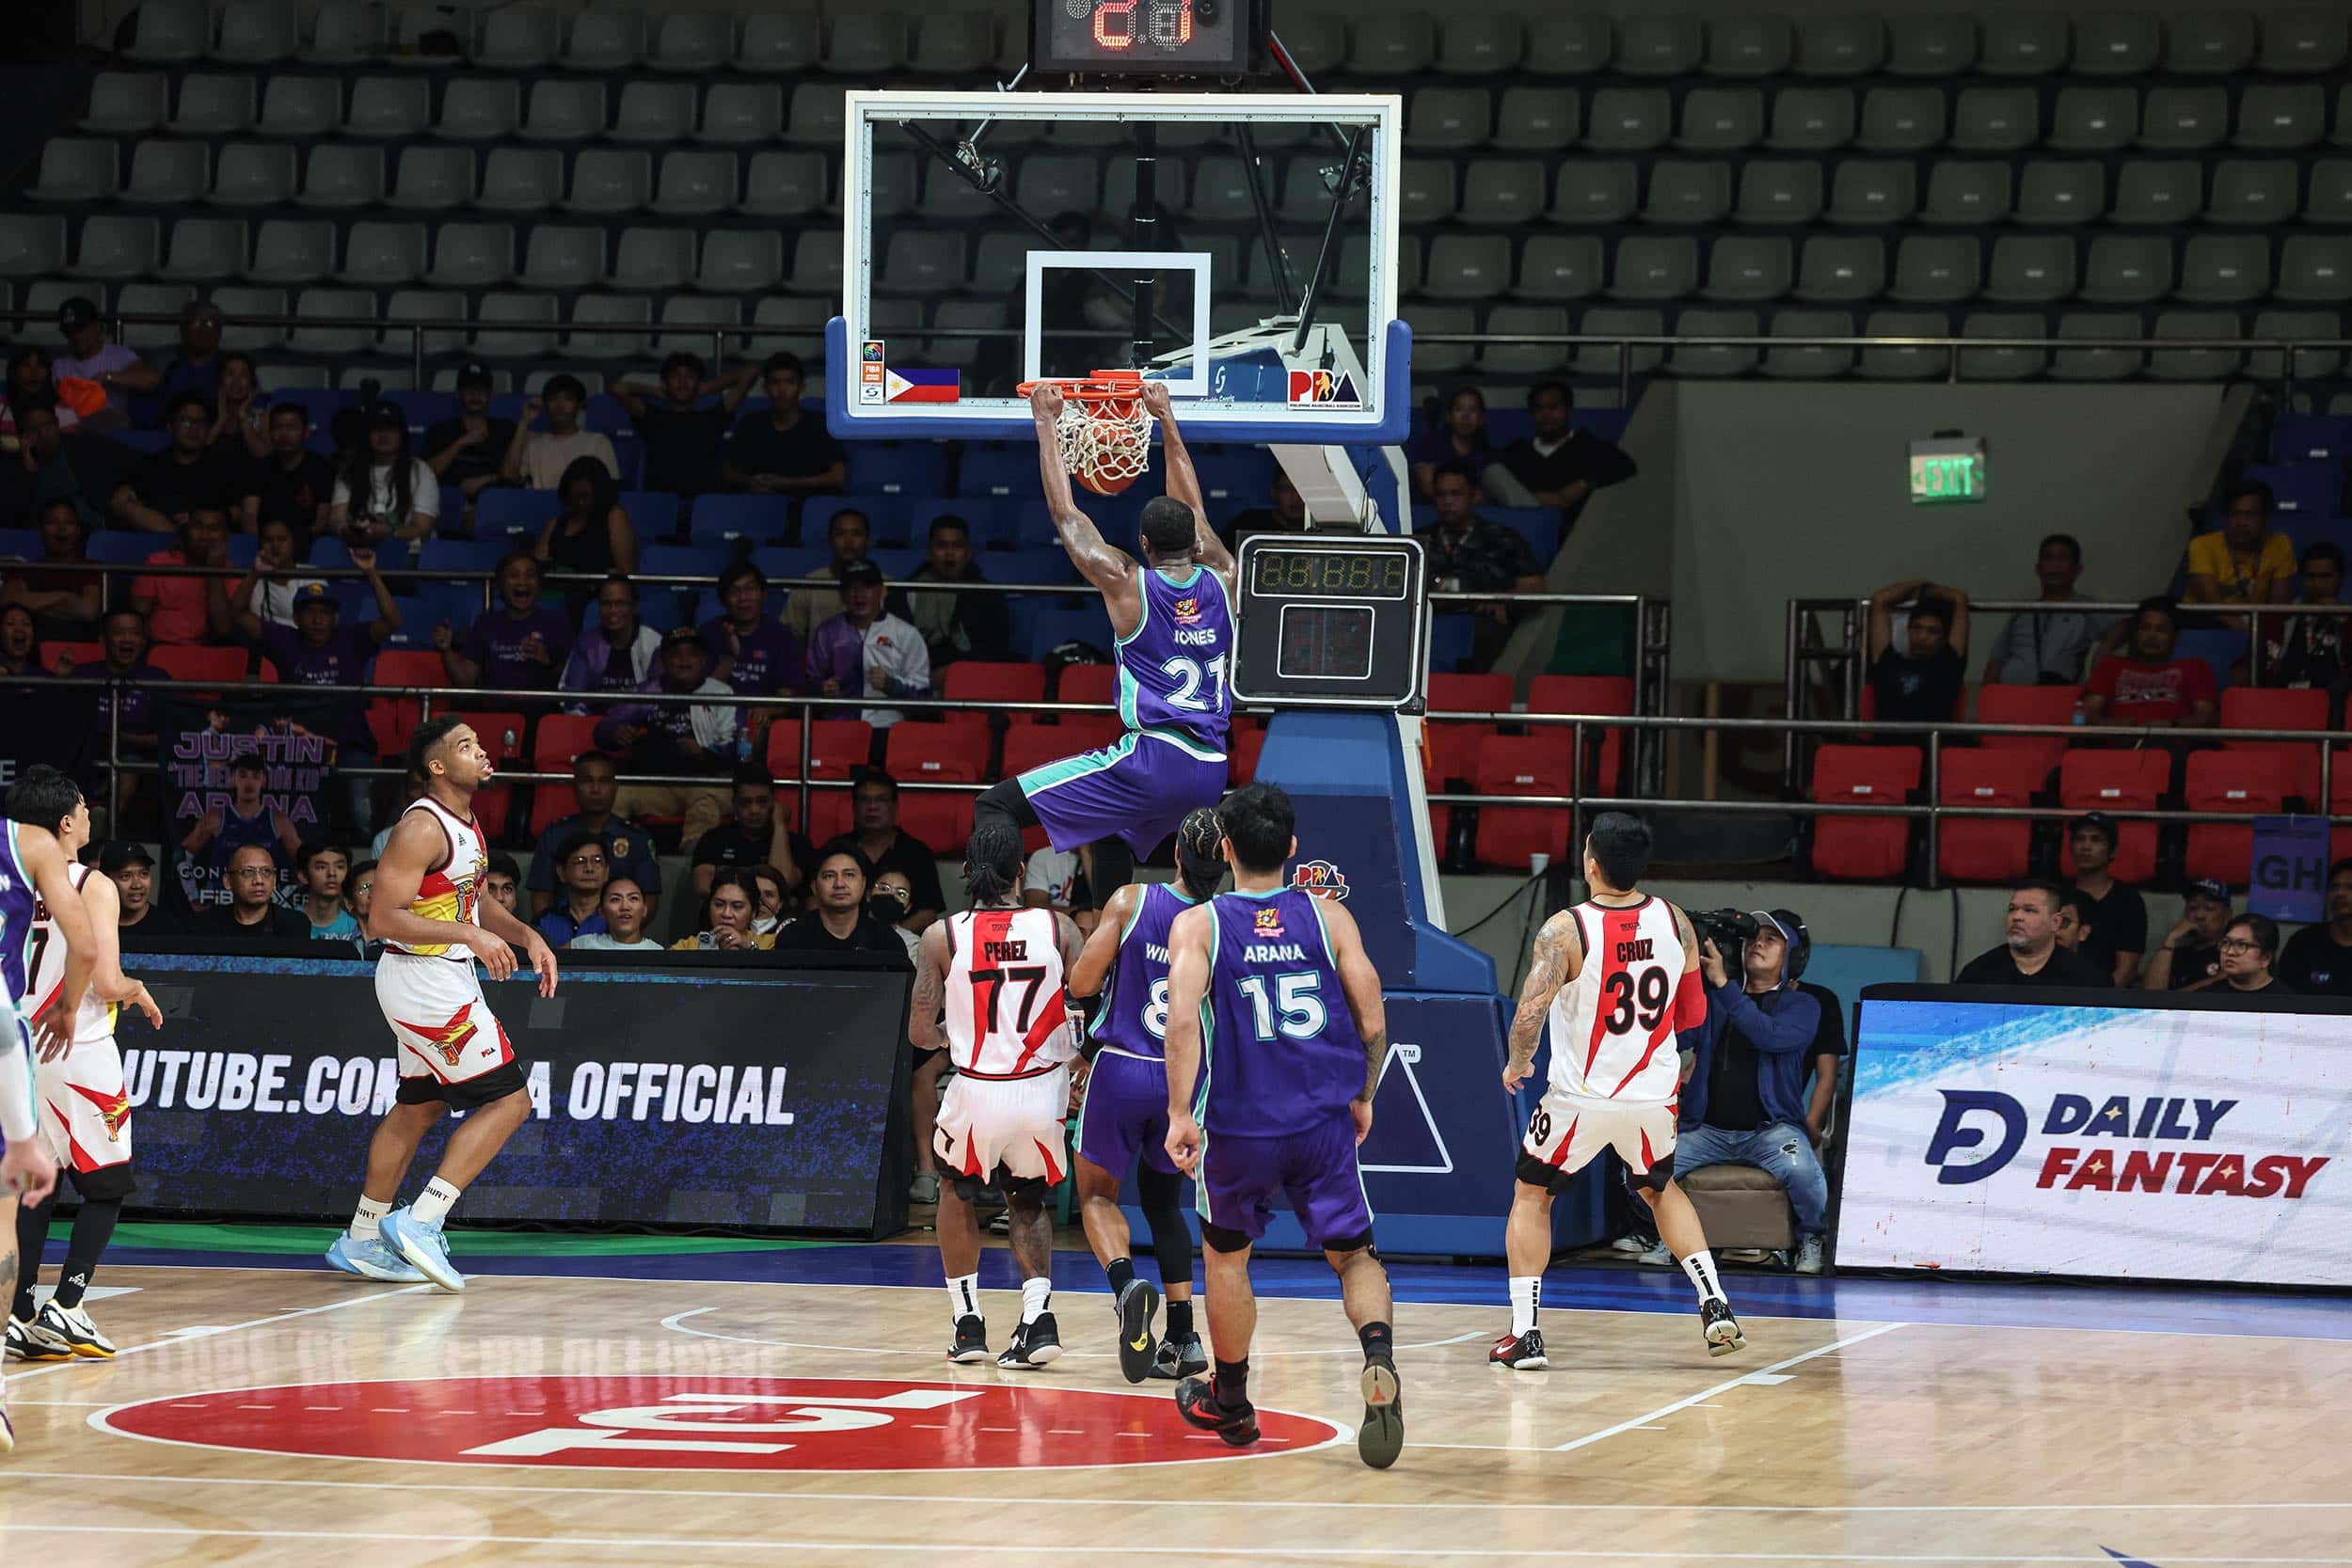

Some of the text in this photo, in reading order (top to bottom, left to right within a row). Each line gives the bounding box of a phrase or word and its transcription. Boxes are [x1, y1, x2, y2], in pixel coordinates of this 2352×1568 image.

[1926, 457, 1974, 497] EXIT
[1160, 653, 1226, 713] 21
[2258, 854, 2322, 892] GH
[983, 941, 1027, 961] PEREZ
[1244, 943, 1308, 963] ARANA
[1616, 938, 1654, 963] CRUZ
[968, 965, 1047, 1034] 77
[1140, 977, 1169, 1040] 8
[1236, 970, 1328, 1041] 15
[1604, 965, 1670, 1037] 39
[567, 1061, 794, 1125] OFFICIAL
[2041, 1093, 2239, 1141] DAILY
[2035, 1148, 2331, 1199] FANTASY
